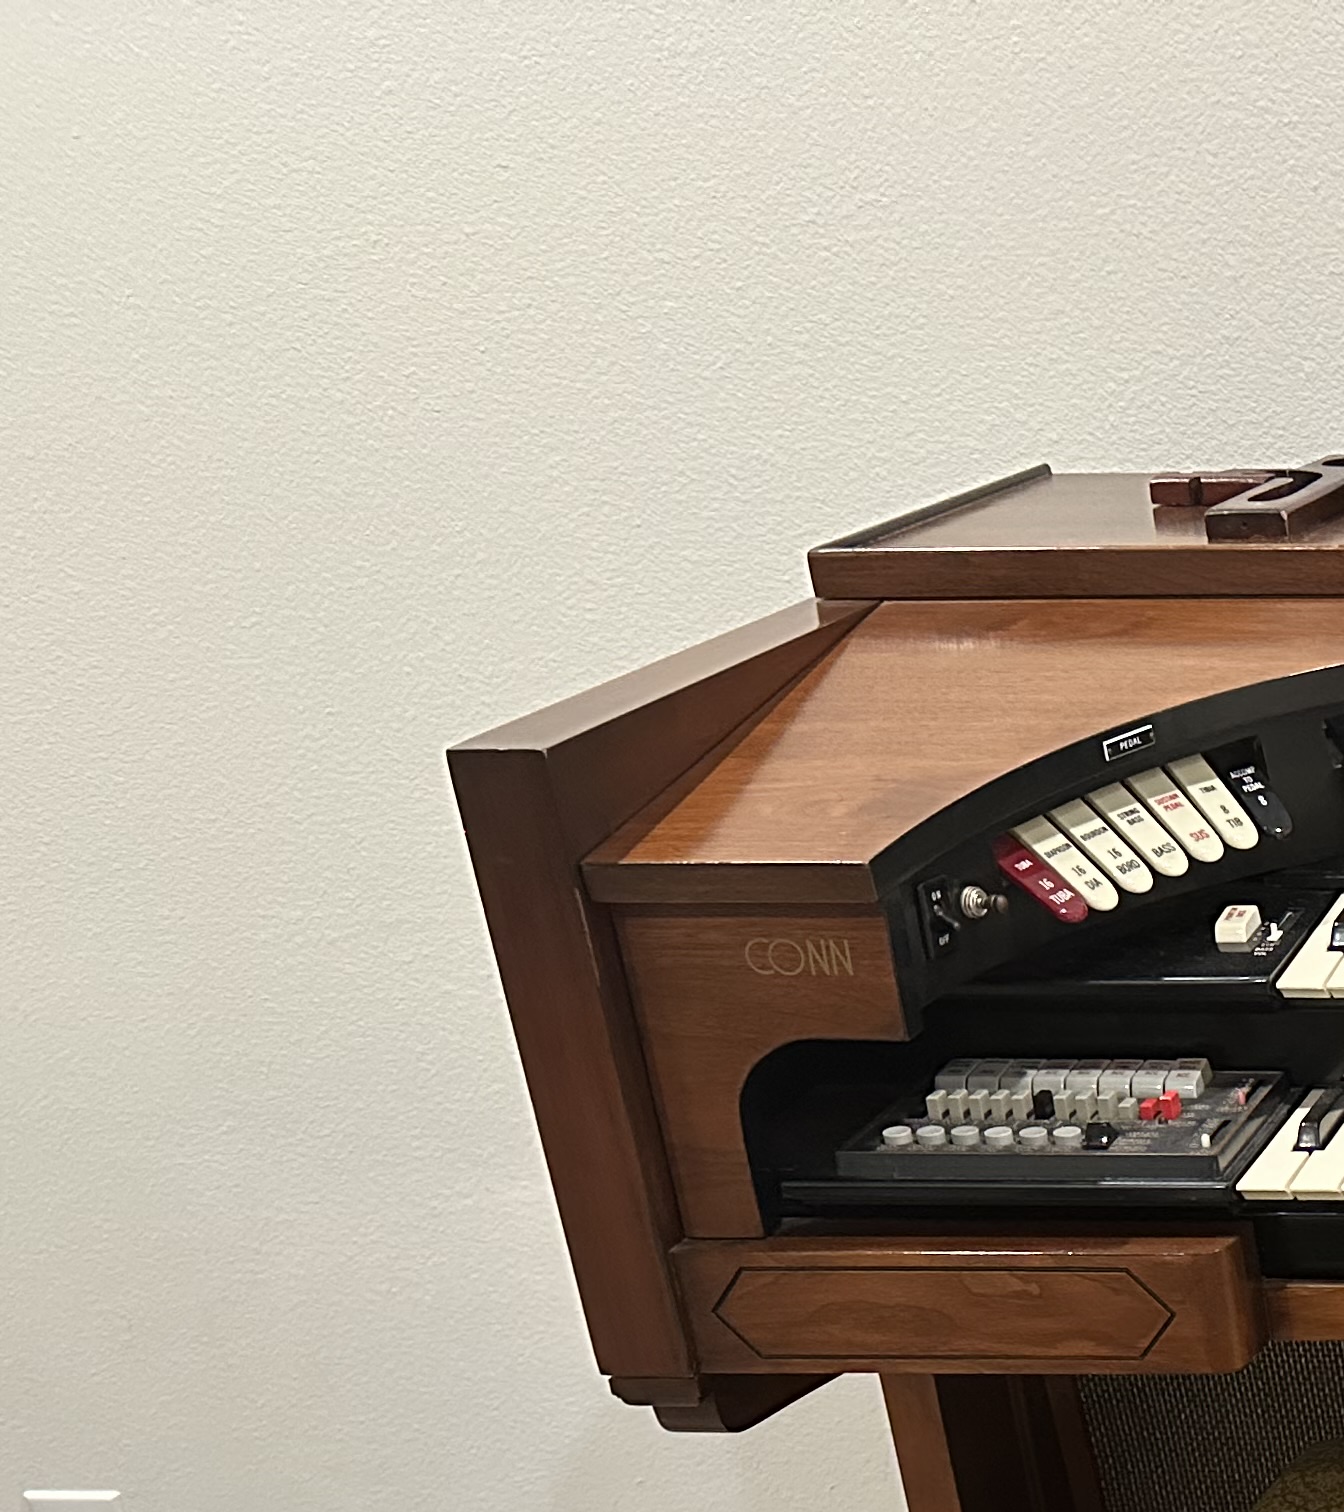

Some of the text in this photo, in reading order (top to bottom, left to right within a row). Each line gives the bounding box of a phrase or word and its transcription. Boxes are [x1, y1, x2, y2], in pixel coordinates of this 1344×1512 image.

[1120, 737, 1142, 751] PEDAL
[1242, 781, 1265, 792] PEDAL
[1163, 801, 1184, 812] PEDAL
[1257, 795, 1268, 805] 8
[1117, 807, 1140, 820] STRING
[1220, 805, 1229, 814] 8
[1126, 815, 1144, 826] BASS
[1226, 817, 1243, 828] TIB
[1189, 829, 1210, 842] SUS
[1107, 847, 1122, 860] 16
[1151, 842, 1176, 858] BASS
[1014, 859, 1033, 872] TUBA
[1071, 865, 1087, 877] 16
[1116, 859, 1141, 875] BORD
[1038, 878, 1054, 890] 16
[1084, 877, 1102, 891] DIA
[1049, 888, 1075, 905] TUBA
[745, 937, 854, 976] CONN
